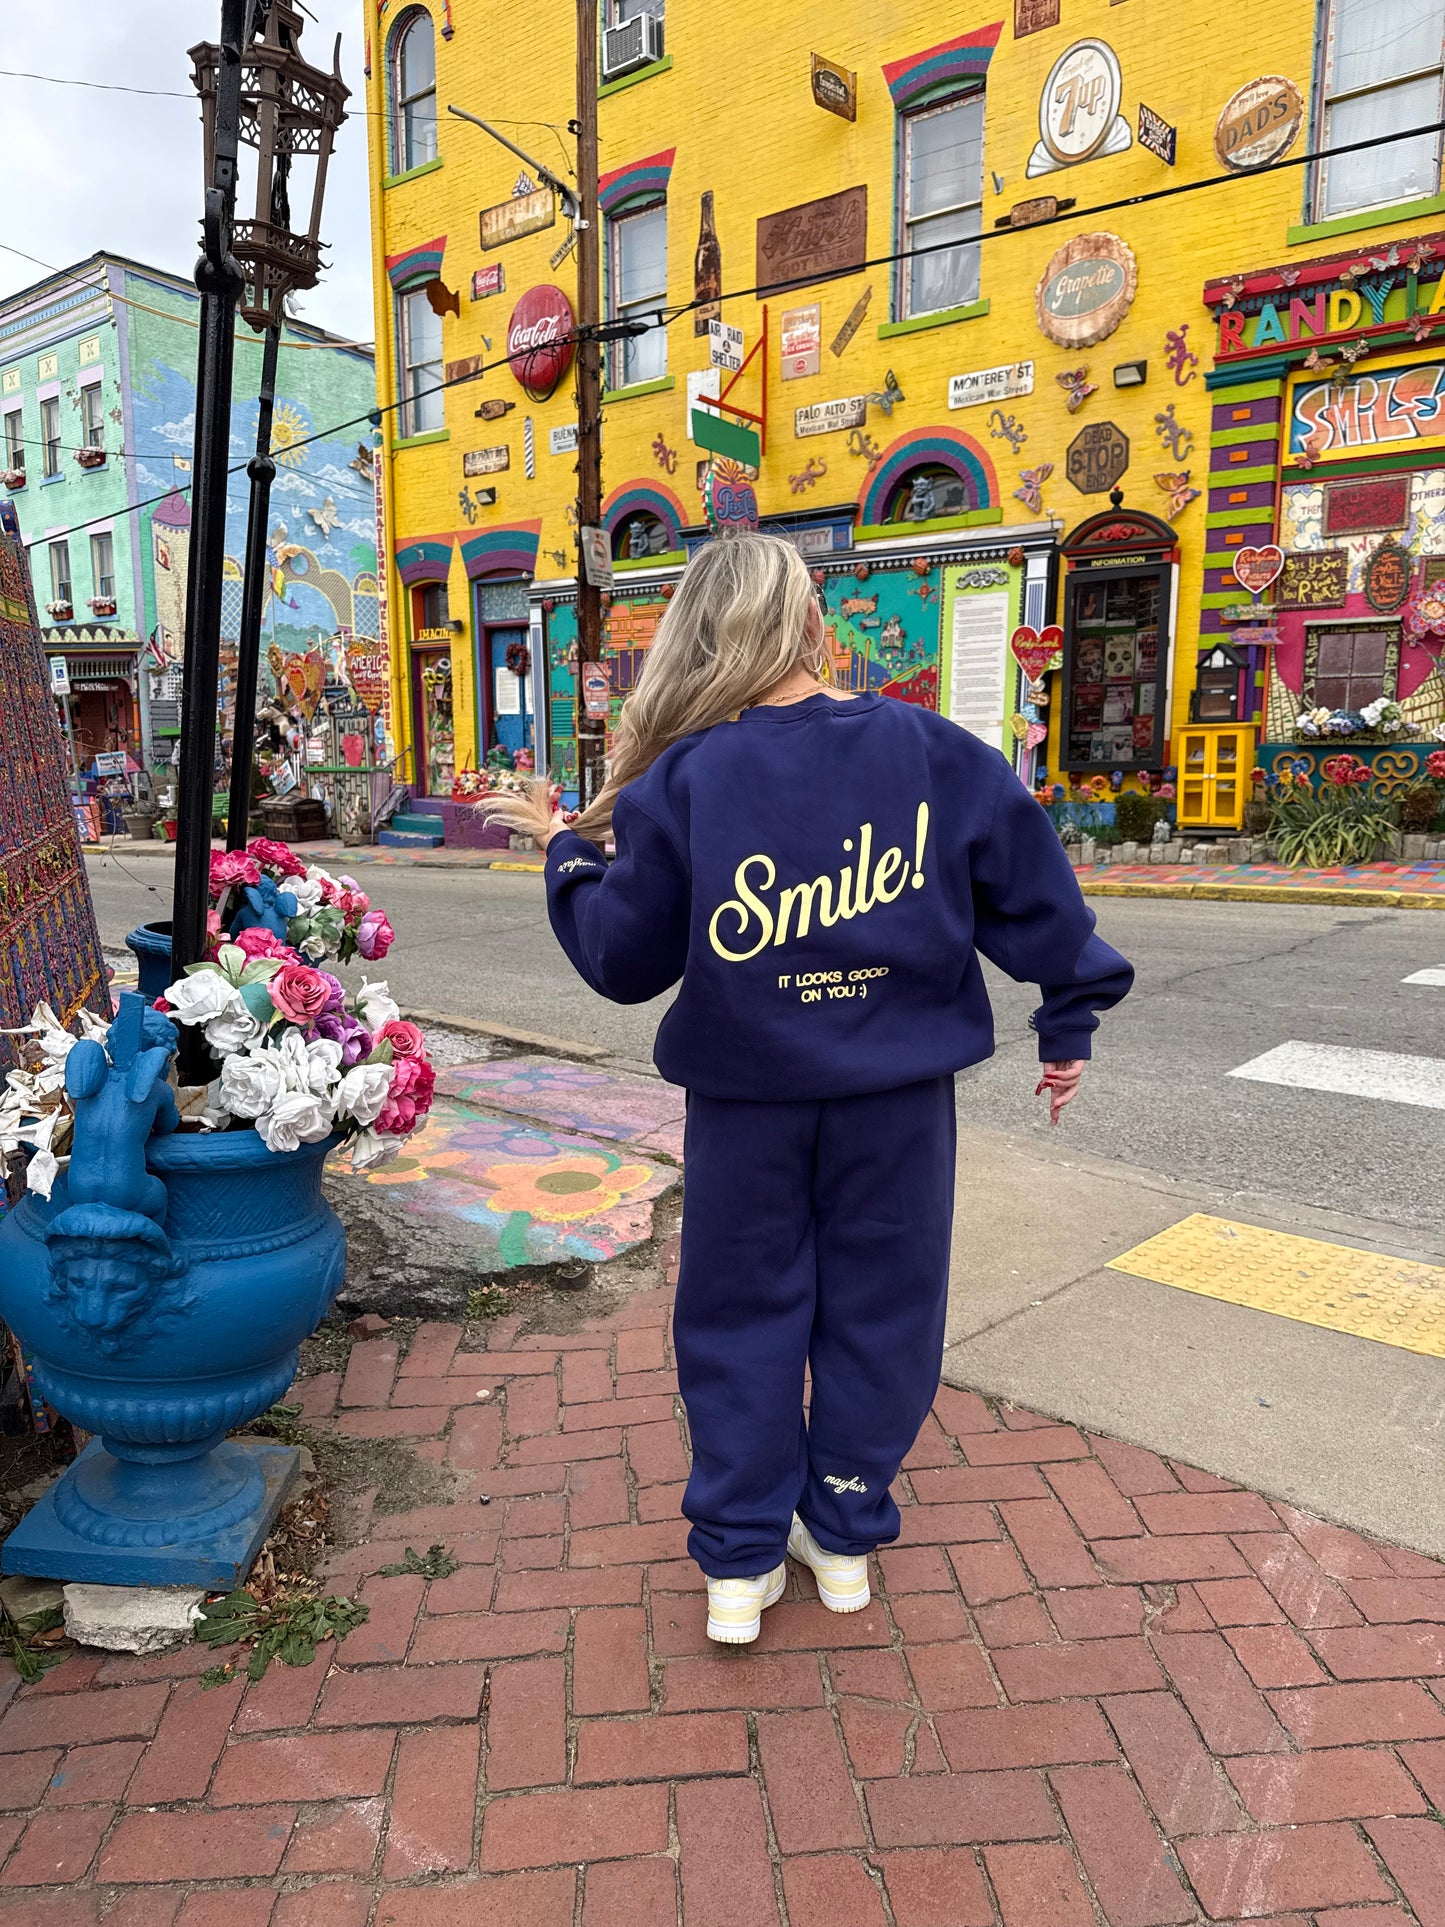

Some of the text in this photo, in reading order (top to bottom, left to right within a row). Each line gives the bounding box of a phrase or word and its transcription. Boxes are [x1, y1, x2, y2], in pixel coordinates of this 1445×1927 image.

[1226, 92, 1287, 151] DAD'S
[1051, 264, 1115, 310] Grapette
[710, 321, 743, 345] AIR RAID
[711, 349, 742, 371] SHELTER
[953, 368, 1013, 391] MONTEREY
[798, 406, 821, 421] PALO
[824, 402, 847, 417] ALTO
[1070, 442, 1125, 475] STOP
[1086, 472, 1107, 489] END
[802, 530, 830, 546] CITY
[1090, 556, 1146, 568] INFORMATION
[375, 453, 391, 731] INTERNATIONAL WELCOME HOUSE
[709, 801, 929, 962] Smile!
[778, 967, 890, 989] IT LOOKS GOOD
[801, 989, 822, 1003] ON
[827, 985, 856, 999] YOU
[823, 1475, 868, 1494] mayfair
